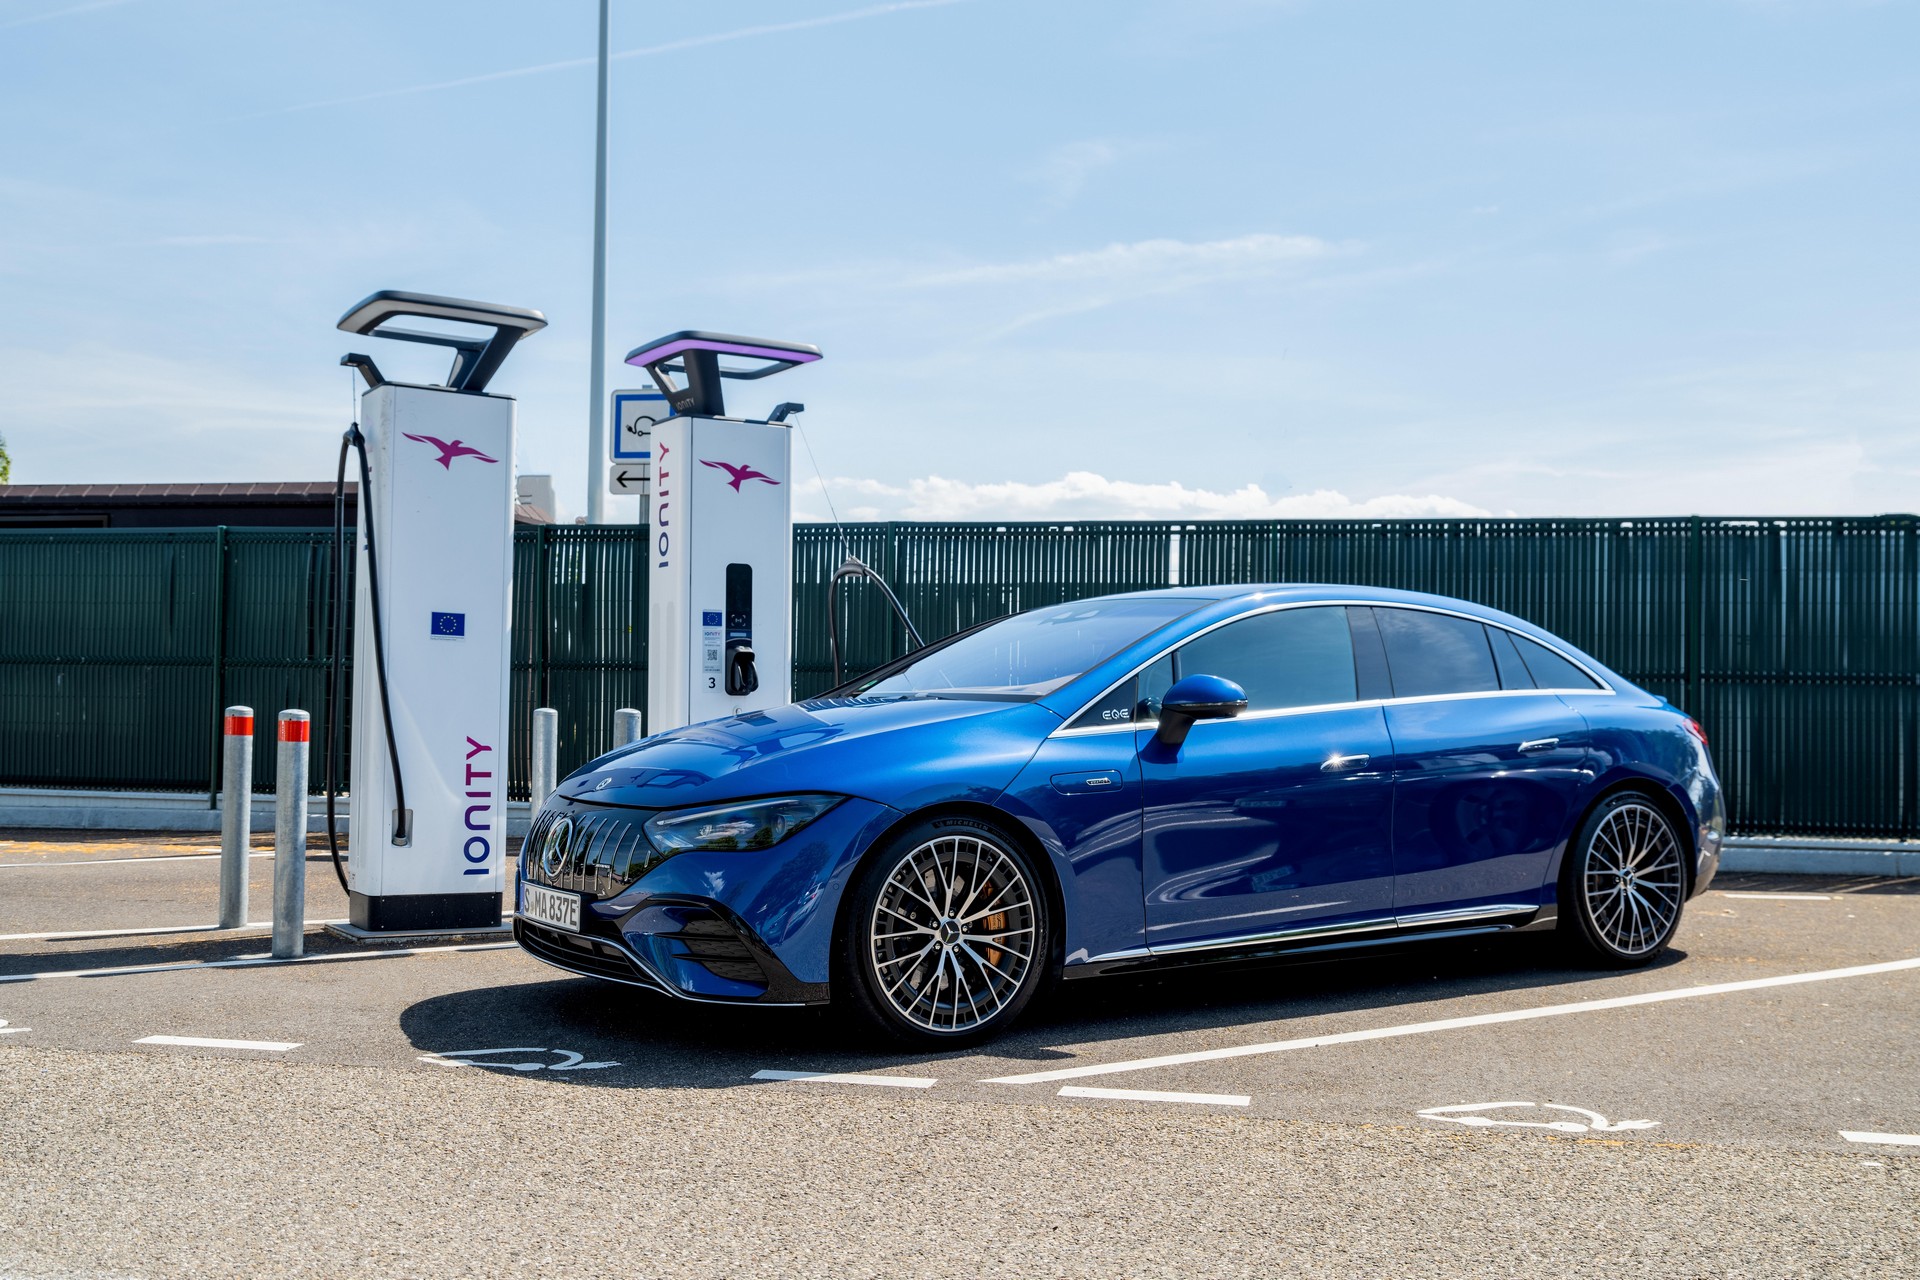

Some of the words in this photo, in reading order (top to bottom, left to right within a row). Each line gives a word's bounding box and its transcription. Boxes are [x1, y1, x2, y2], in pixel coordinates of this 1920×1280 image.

[658, 441, 670, 568] IONITY
[708, 677, 716, 689] 3
[1102, 708, 1130, 720] EQE
[463, 736, 492, 875] IONITY
[946, 819, 990, 832] MICHELIN
[524, 888, 530, 912] S
[535, 891, 547, 918] MA
[550, 895, 577, 926] 837E
